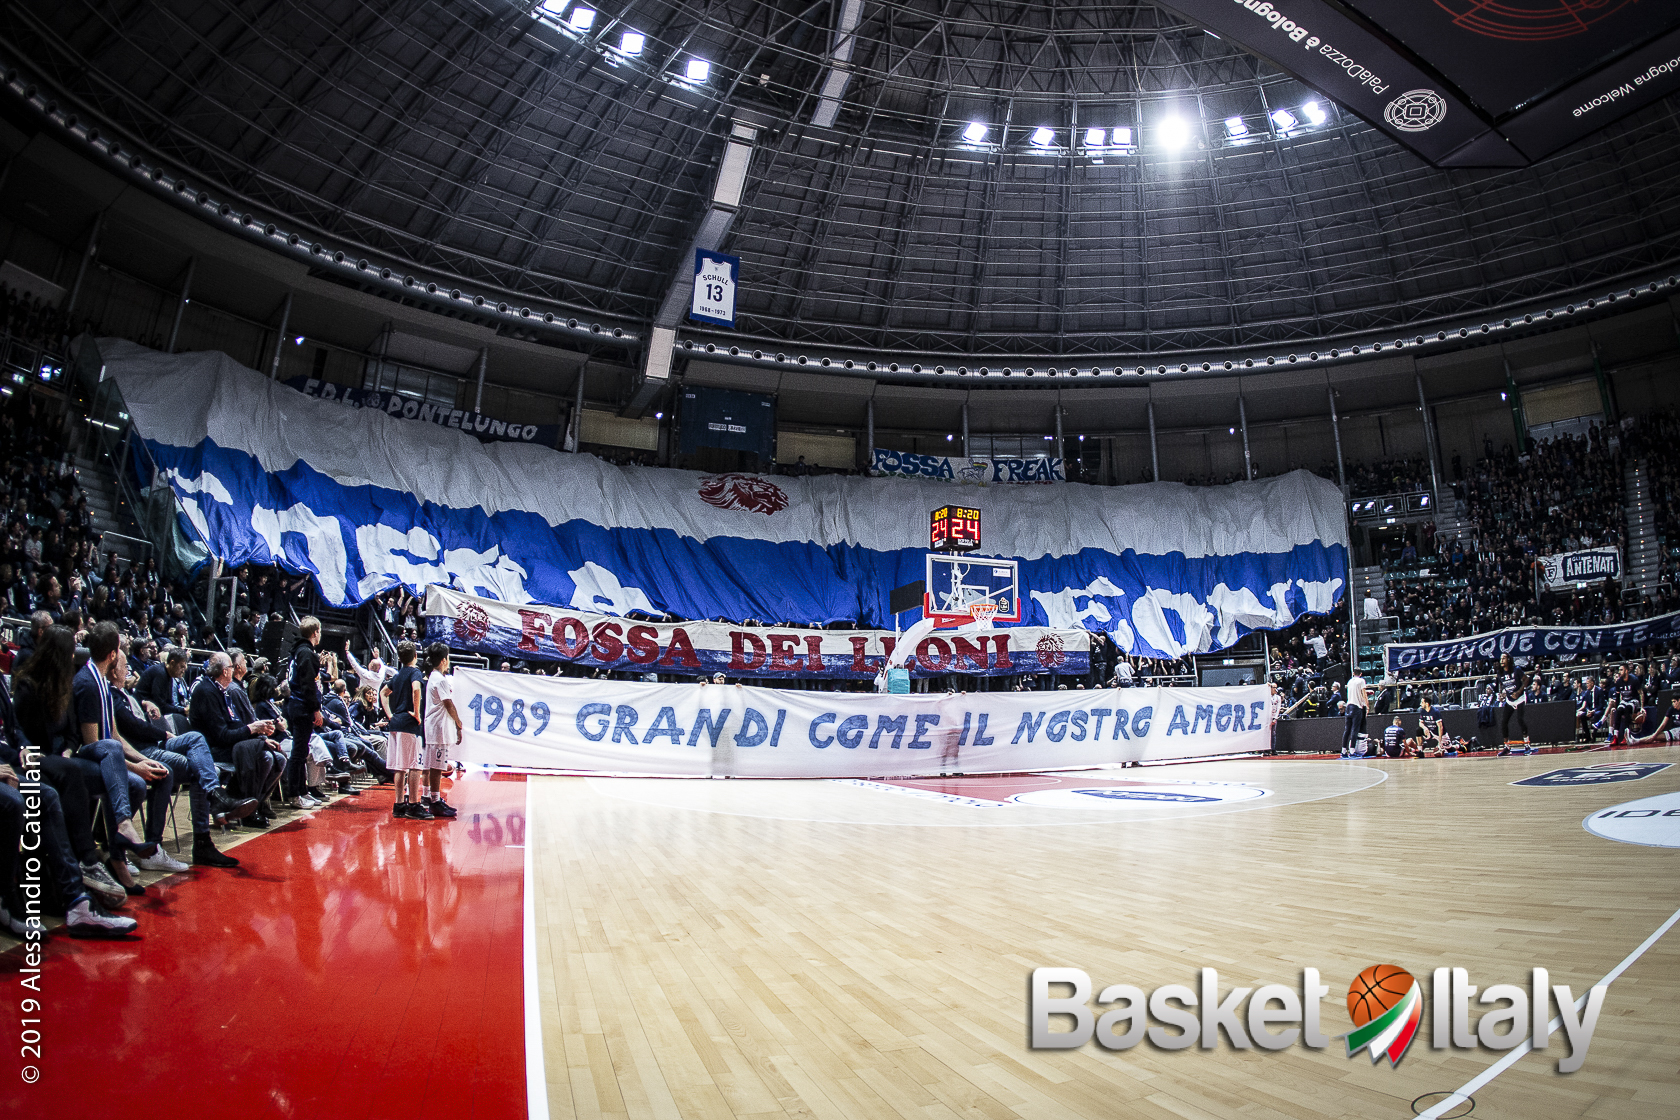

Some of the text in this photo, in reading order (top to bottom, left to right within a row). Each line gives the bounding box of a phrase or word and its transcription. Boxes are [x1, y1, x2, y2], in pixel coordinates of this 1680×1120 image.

[1234, 0, 1390, 95] PalaDozza è Bologn
[1572, 56, 1680, 117] ologna Welcome
[702, 274, 729, 286] SCHULL
[706, 283, 723, 303] 13
[386, 396, 539, 440] PONTELUNGO
[871, 448, 956, 480] FOSSA
[991, 457, 1067, 481] FREAK
[931, 518, 948, 542] 24
[951, 518, 980, 540] 24
[956, 508, 980, 520] 8:20
[1566, 555, 1615, 577] ANTENATI
[517, 608, 702, 668] FOSSA
[727, 631, 826, 671] DEI
[1398, 624, 1649, 668] OVUNQUE CON TE
[468, 693, 1265, 750] 1989 GRANDI COME IL NOSTRO AMORE
